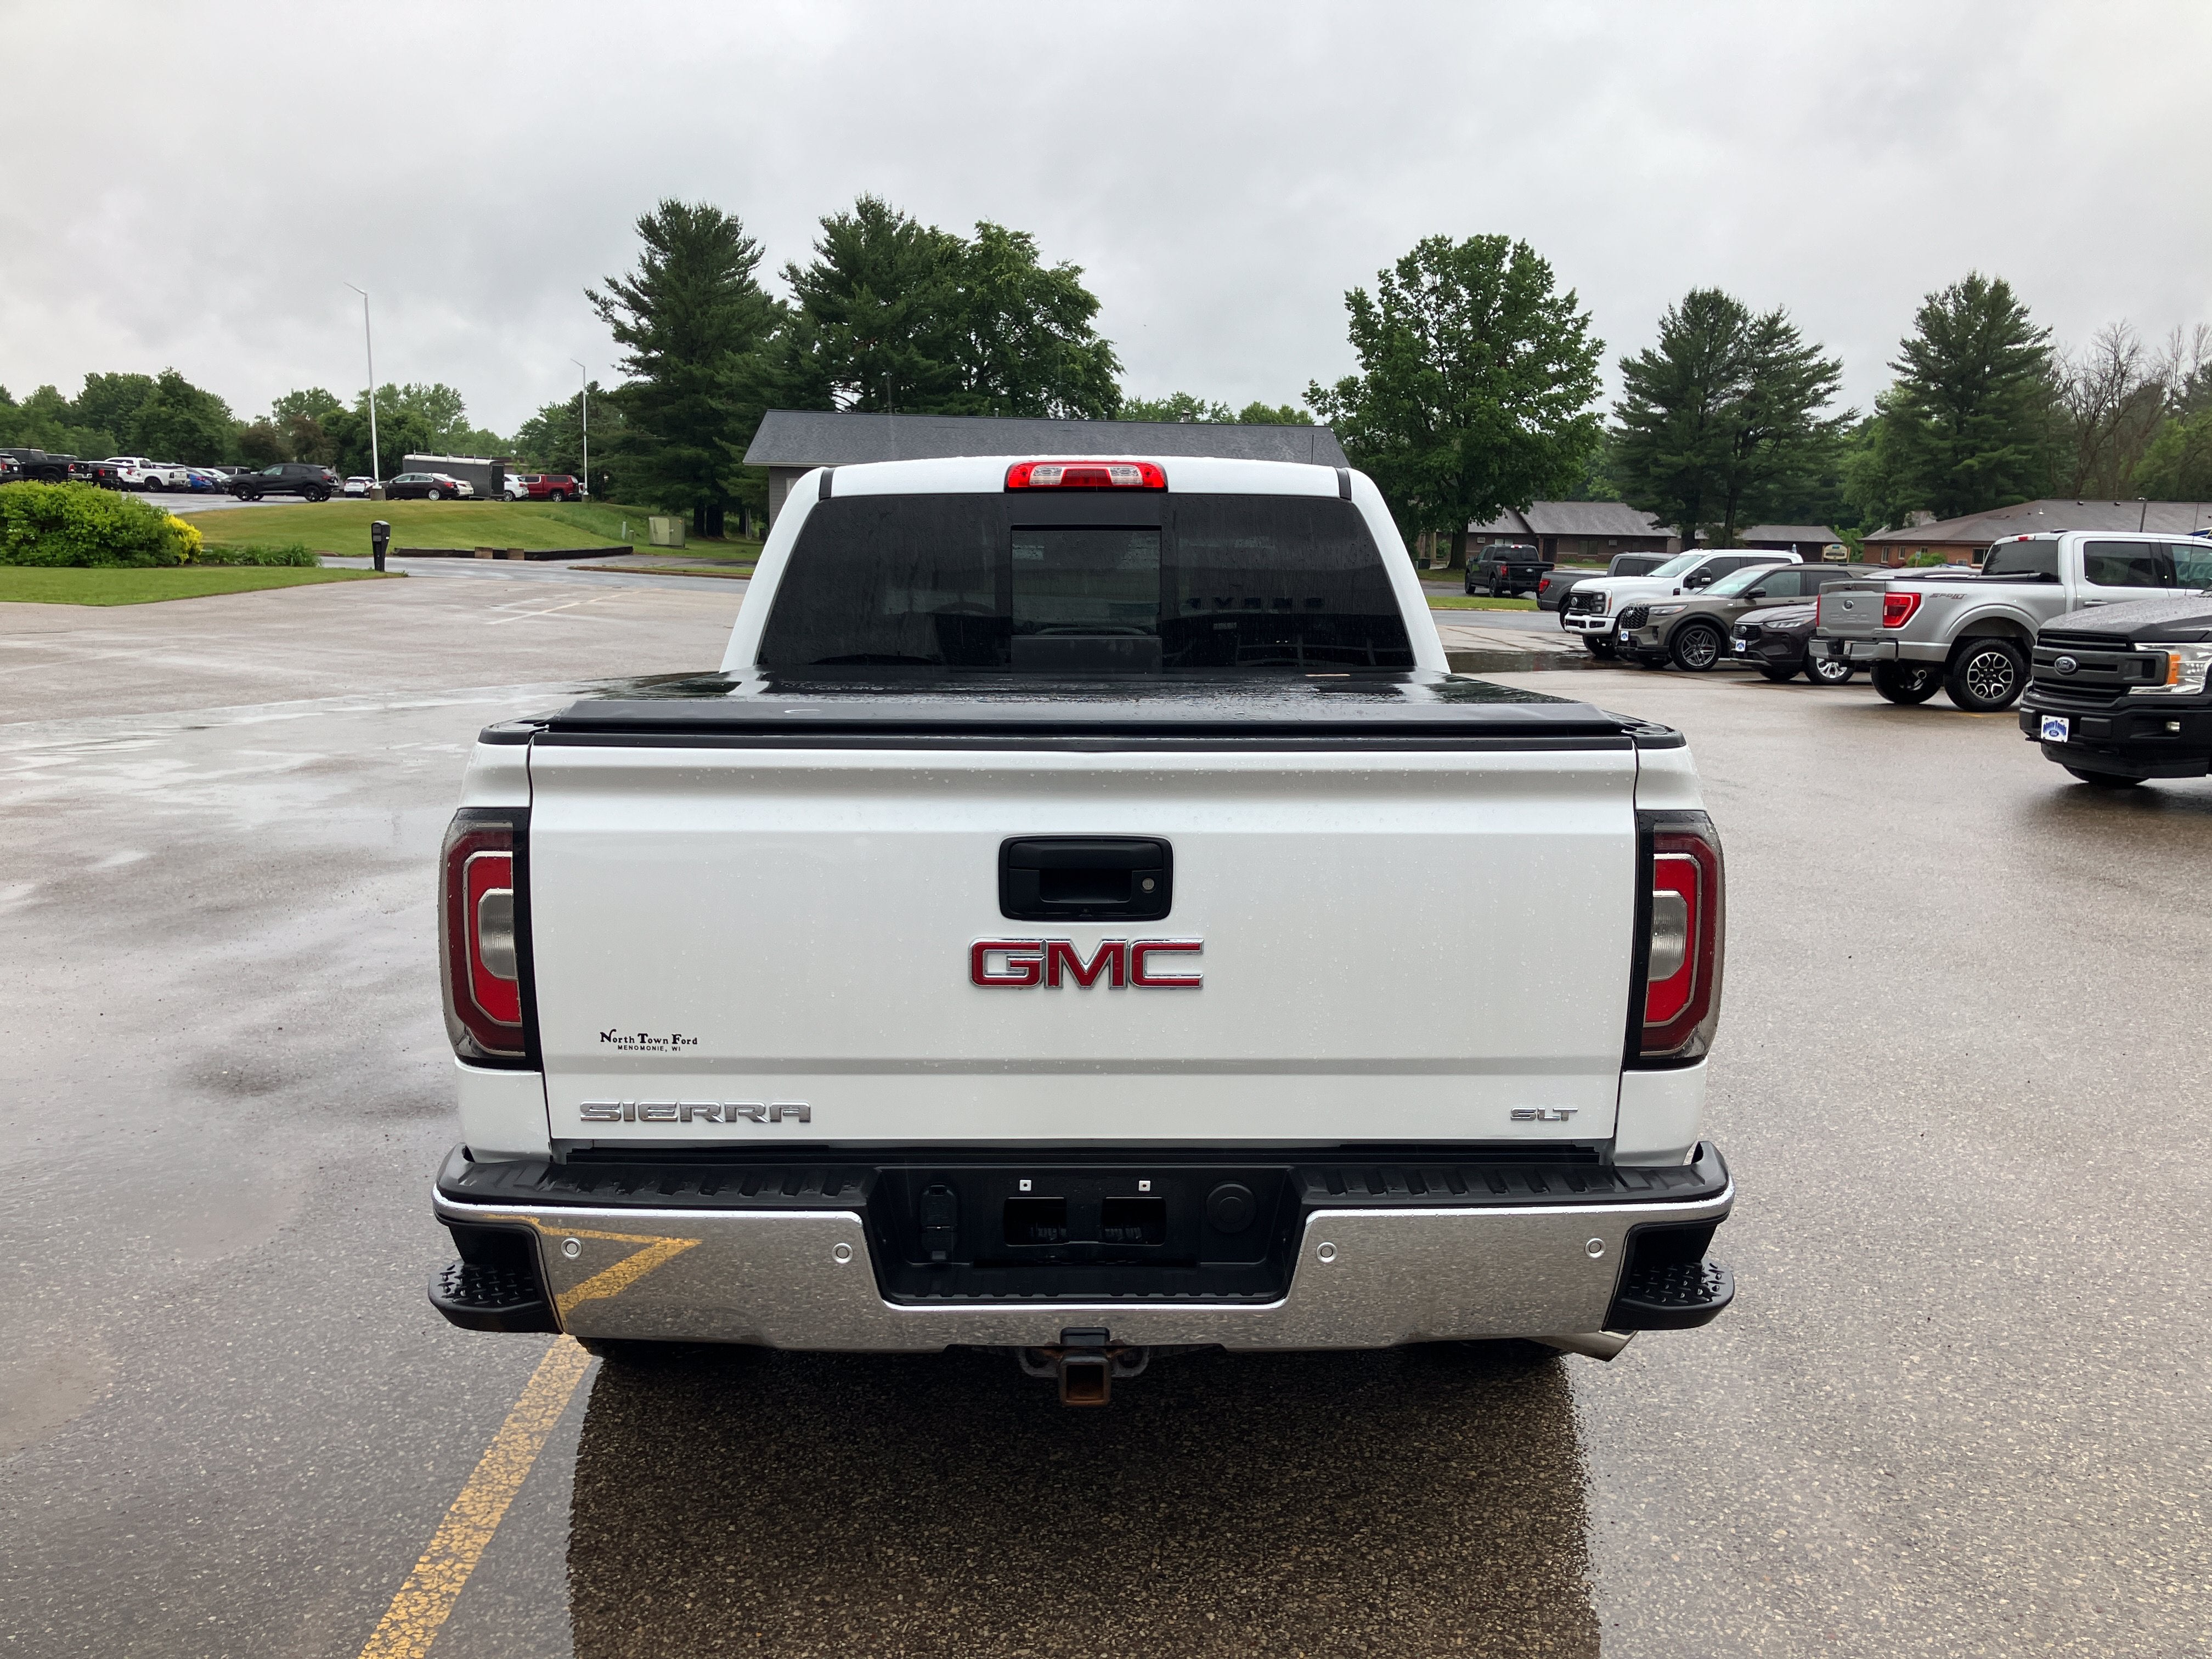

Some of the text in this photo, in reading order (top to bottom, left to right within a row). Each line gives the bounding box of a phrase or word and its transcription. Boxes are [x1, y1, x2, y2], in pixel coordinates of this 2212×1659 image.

[968, 937, 1204, 989] GMC
[600, 1028, 698, 1045] North Town Ford
[580, 1101, 811, 1123] SIERRA
[1510, 1107, 1578, 1121] SLT
